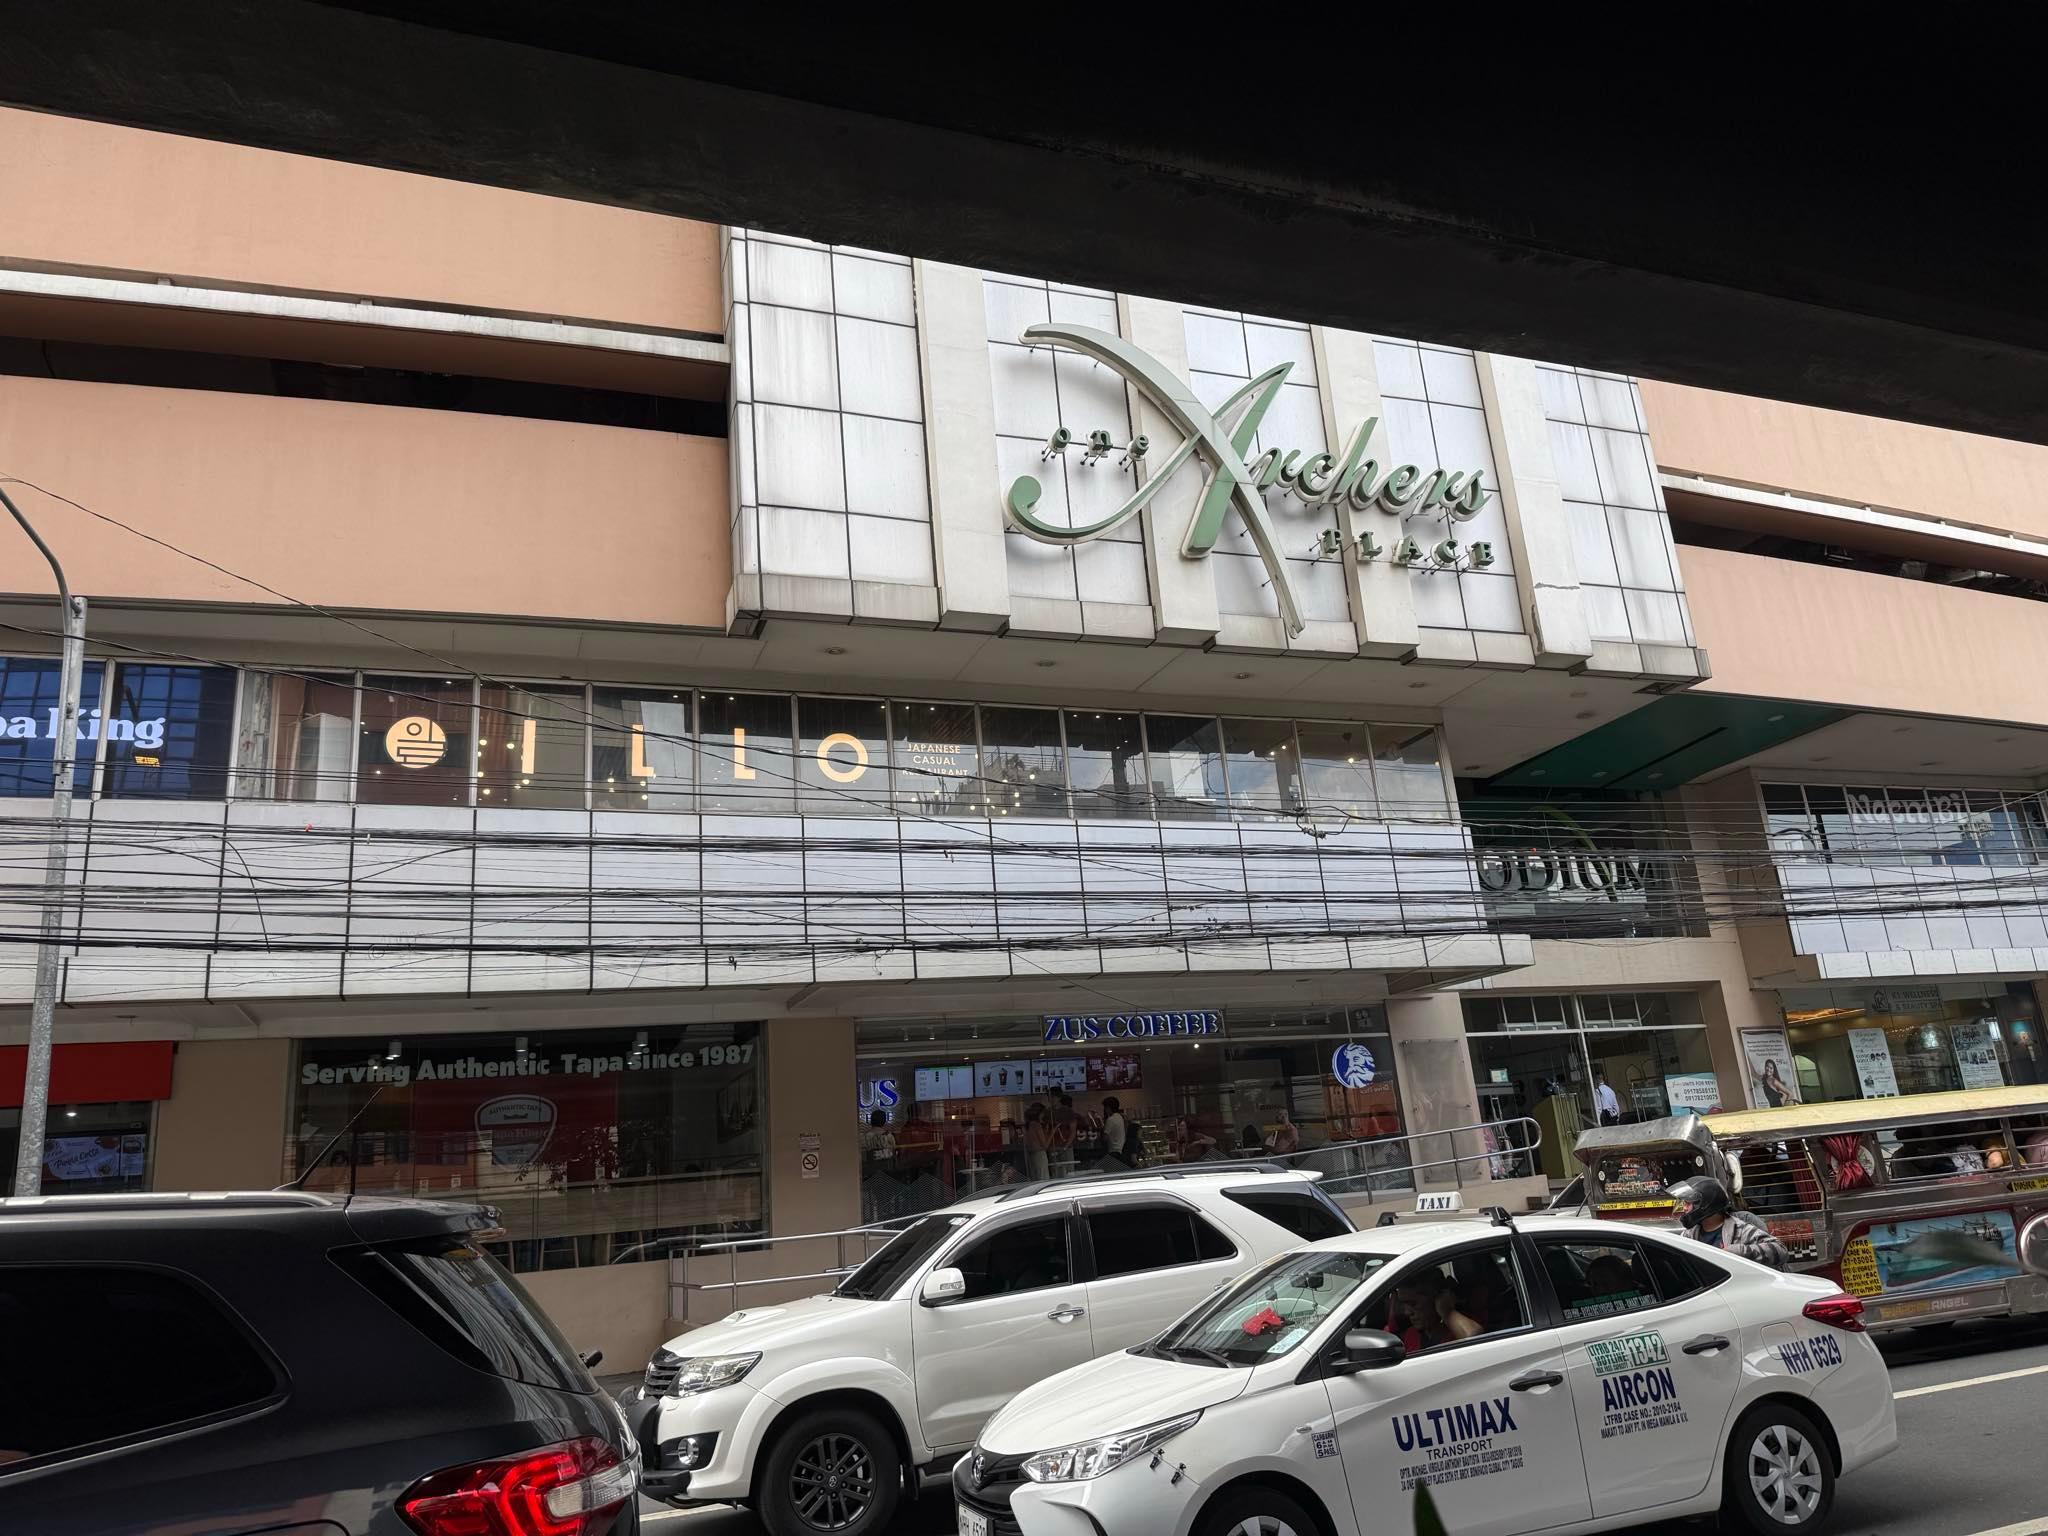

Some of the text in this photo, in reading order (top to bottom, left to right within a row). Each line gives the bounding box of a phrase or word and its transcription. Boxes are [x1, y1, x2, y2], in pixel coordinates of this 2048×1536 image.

[1046, 426, 1149, 462] one
[1003, 322, 1491, 639] Archers
[1319, 527, 1495, 570] PLACE
[0, 716, 37, 739] a
[907, 743, 960, 754] JAPANESE
[913, 755, 956, 766] CASUAL
[1044, 1012, 1219, 1041] ZUS COFFEE
[301, 1044, 753, 1087] Serving Authentic Tapa since 1987
[1419, 1196, 1451, 1210] TAXI
[1931, 1296, 1969, 1311] ANGEL
[1588, 1341, 1610, 1357] LTFRB
[1627, 1334, 1667, 1366] 1342
[1777, 1333, 1842, 1375] NHH 6529
[1603, 1367, 1676, 1412] AIRCON
[1391, 1396, 1518, 1452] ULTIMAX
[1604, 1413, 1623, 1426] LTFRB
[1623, 1410, 1639, 1422] CASE
[1316, 1441, 1322, 1449] 6
[1318, 1449, 1324, 1457] 5
[1426, 1438, 1493, 1460] TRANSPORT
